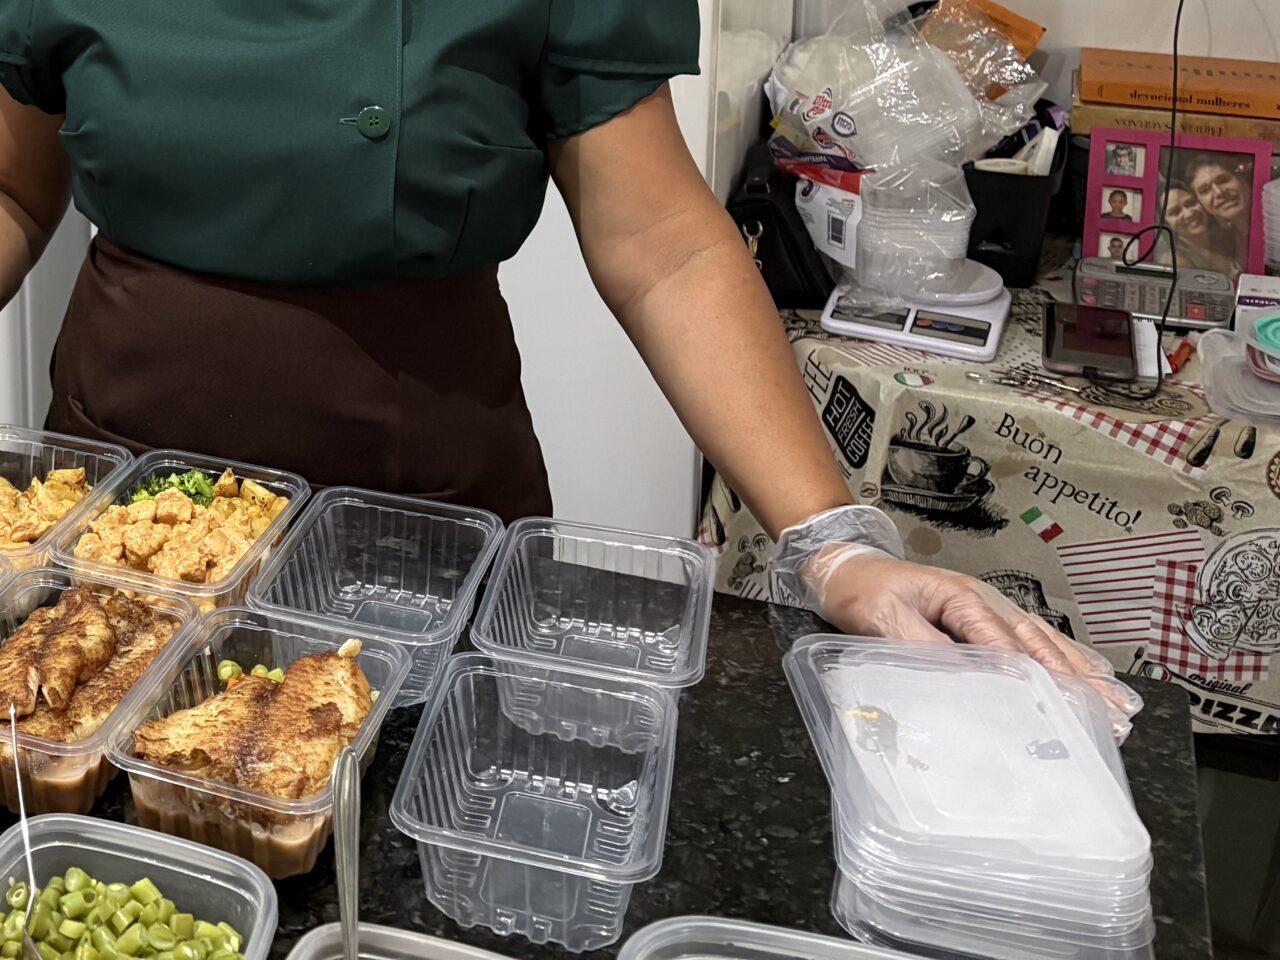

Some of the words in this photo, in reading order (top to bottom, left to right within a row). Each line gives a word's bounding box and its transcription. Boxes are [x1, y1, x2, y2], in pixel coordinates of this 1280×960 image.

[1197, 96, 1251, 109] mulheres
[826, 380, 851, 427] HOT
[837, 400, 863, 443] FRESH
[994, 412, 1063, 464] Buon
[1024, 465, 1142, 527] appetito!
[1188, 672, 1253, 695] original
